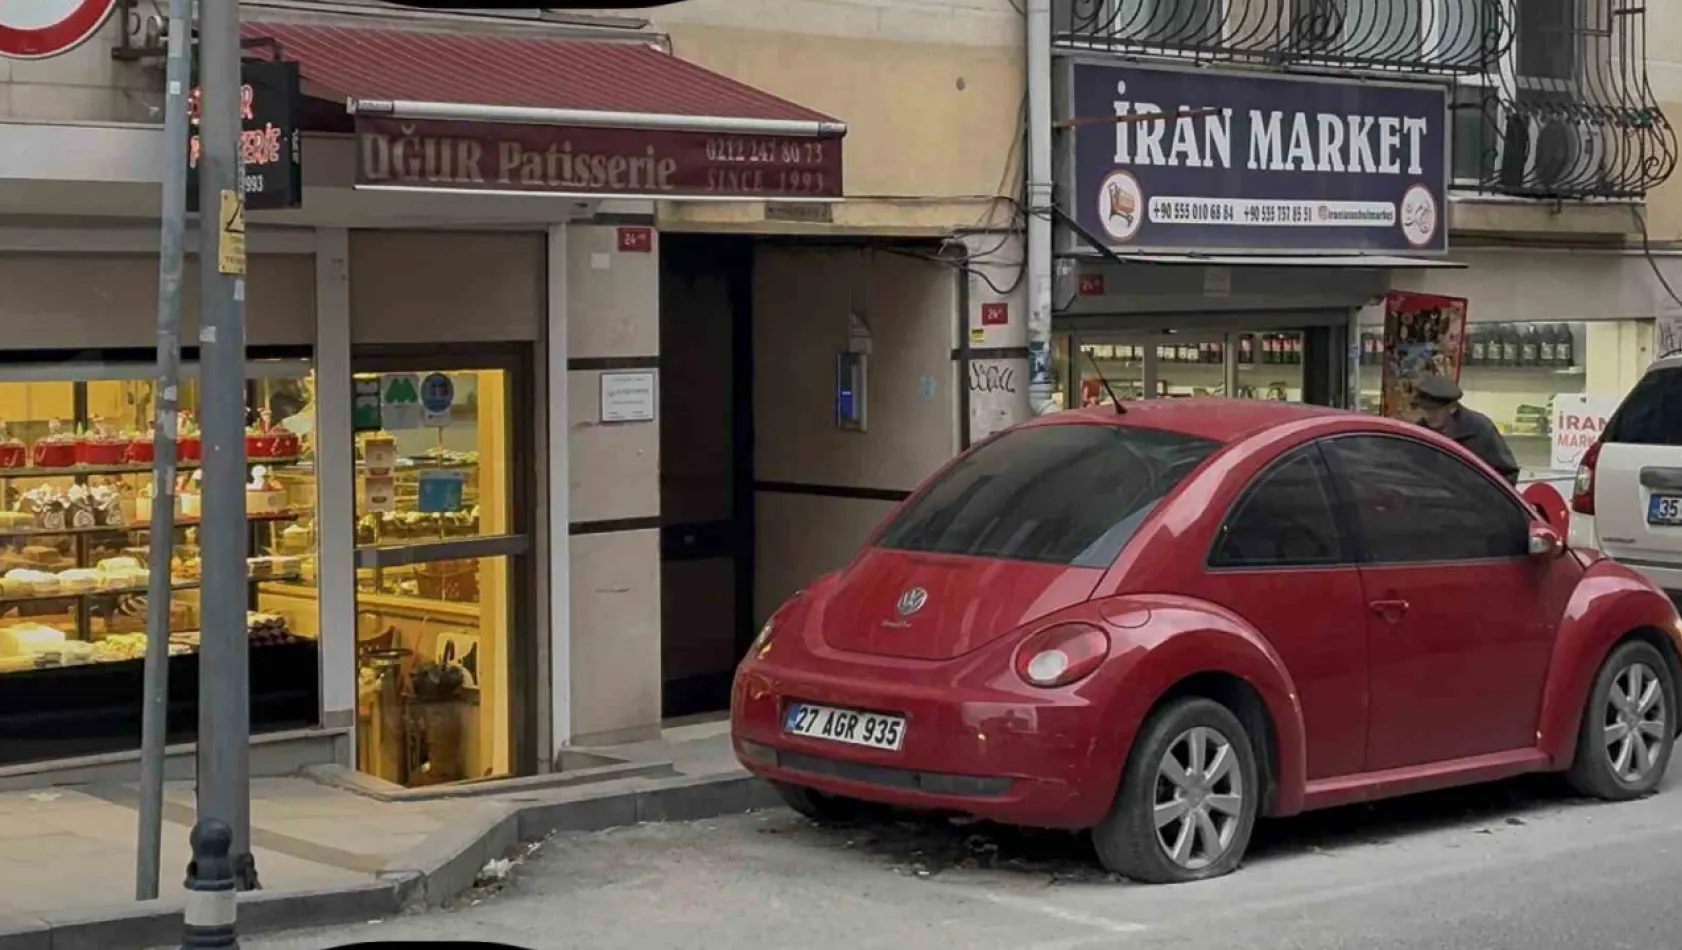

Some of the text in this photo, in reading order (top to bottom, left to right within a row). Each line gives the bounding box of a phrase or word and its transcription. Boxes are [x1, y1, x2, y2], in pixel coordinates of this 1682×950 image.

[1113, 80, 1427, 174] İRAN MARKET
[706, 138, 745, 162] 0212
[497, 141, 677, 190] Patisserie
[243, 174, 264, 193] 993
[706, 168, 824, 193] SINCE 1993
[1153, 201, 1173, 220] +90
[1174, 202, 1190, 220] 555
[1192, 203, 1209, 220] 010
[1244, 205, 1260, 222] +90
[1557, 433, 1597, 448] MARK
[1659, 499, 1679, 518] 35
[794, 706, 901, 746] 27 AGR 935
